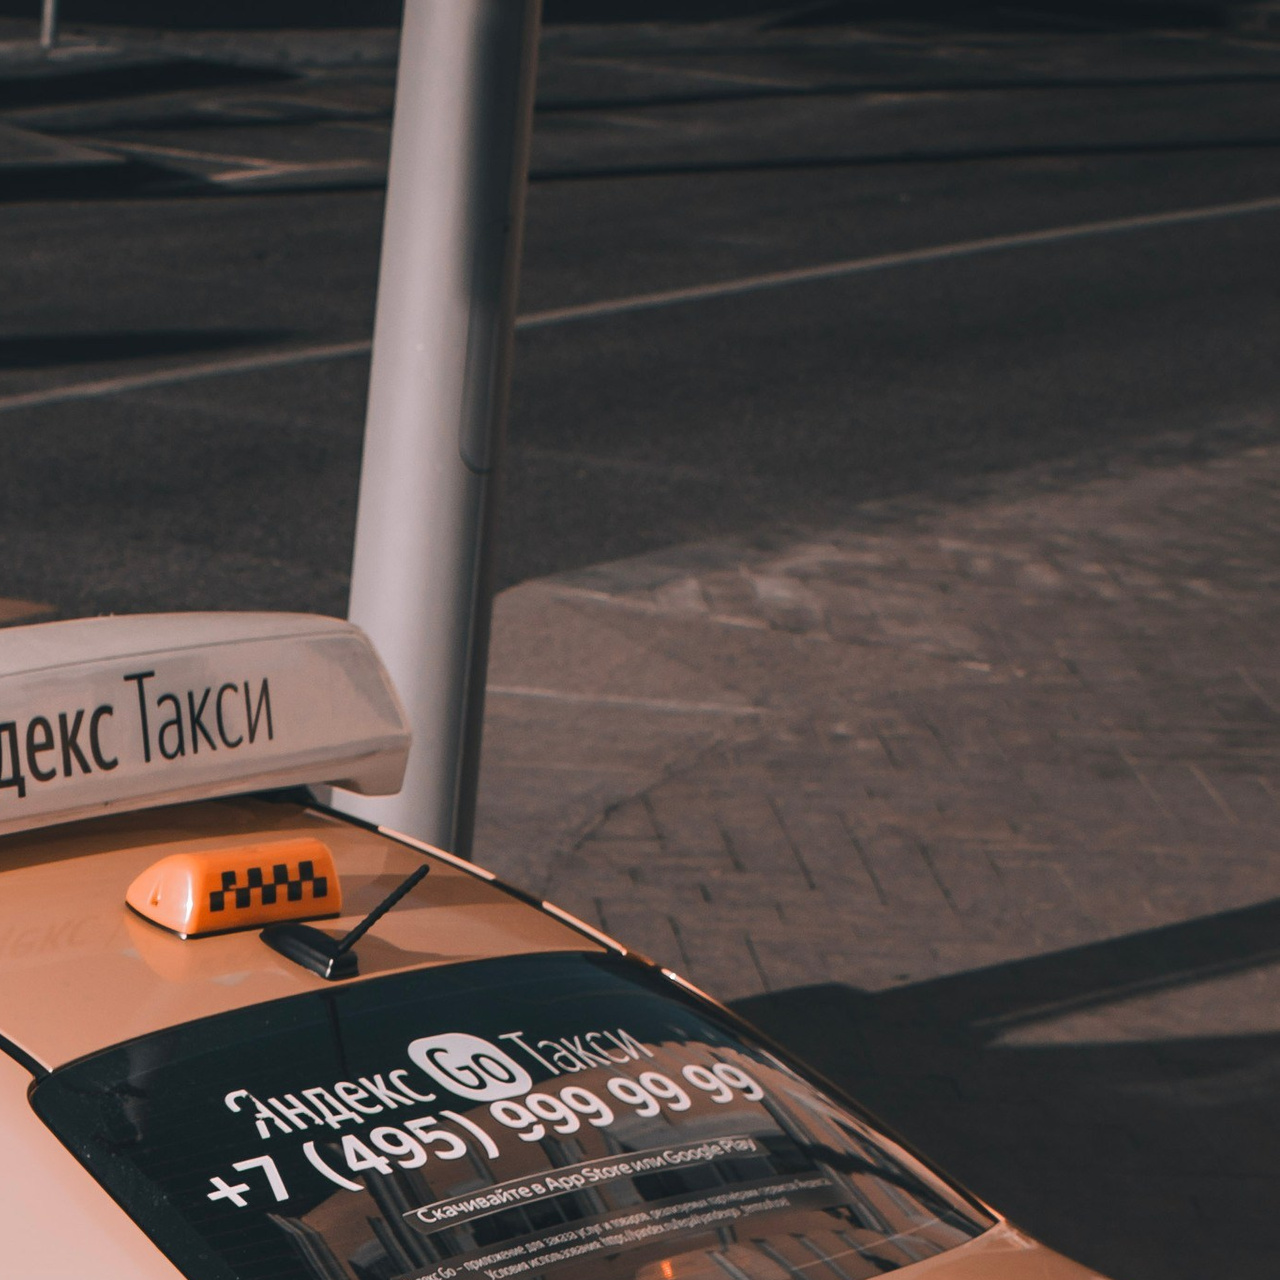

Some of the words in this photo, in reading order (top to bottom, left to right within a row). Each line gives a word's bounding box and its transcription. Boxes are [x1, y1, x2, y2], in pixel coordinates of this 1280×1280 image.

[123, 670, 274, 763] Такси
[224, 1068, 436, 1139] Яндекс
[425, 1047, 518, 1090] Go
[498, 1028, 654, 1076] Такси
[207, 1155, 289, 1207] +7
[303, 1110, 499, 1192] (495)
[489, 1086, 614, 1142] 999
[607, 1071, 691, 1118] 99
[682, 1062, 765, 1103] 99
[416, 1183, 532, 1224] Скачивайте
[532, 1180, 546, 1195] в
[545, 1173, 585, 1195] App
[581, 1156, 632, 1182] Store
[630, 1151, 664, 1174] или
[662, 1141, 724, 1167] Google
[719, 1136, 756, 1155] Play
[438, 1266, 457, 1280] Go
